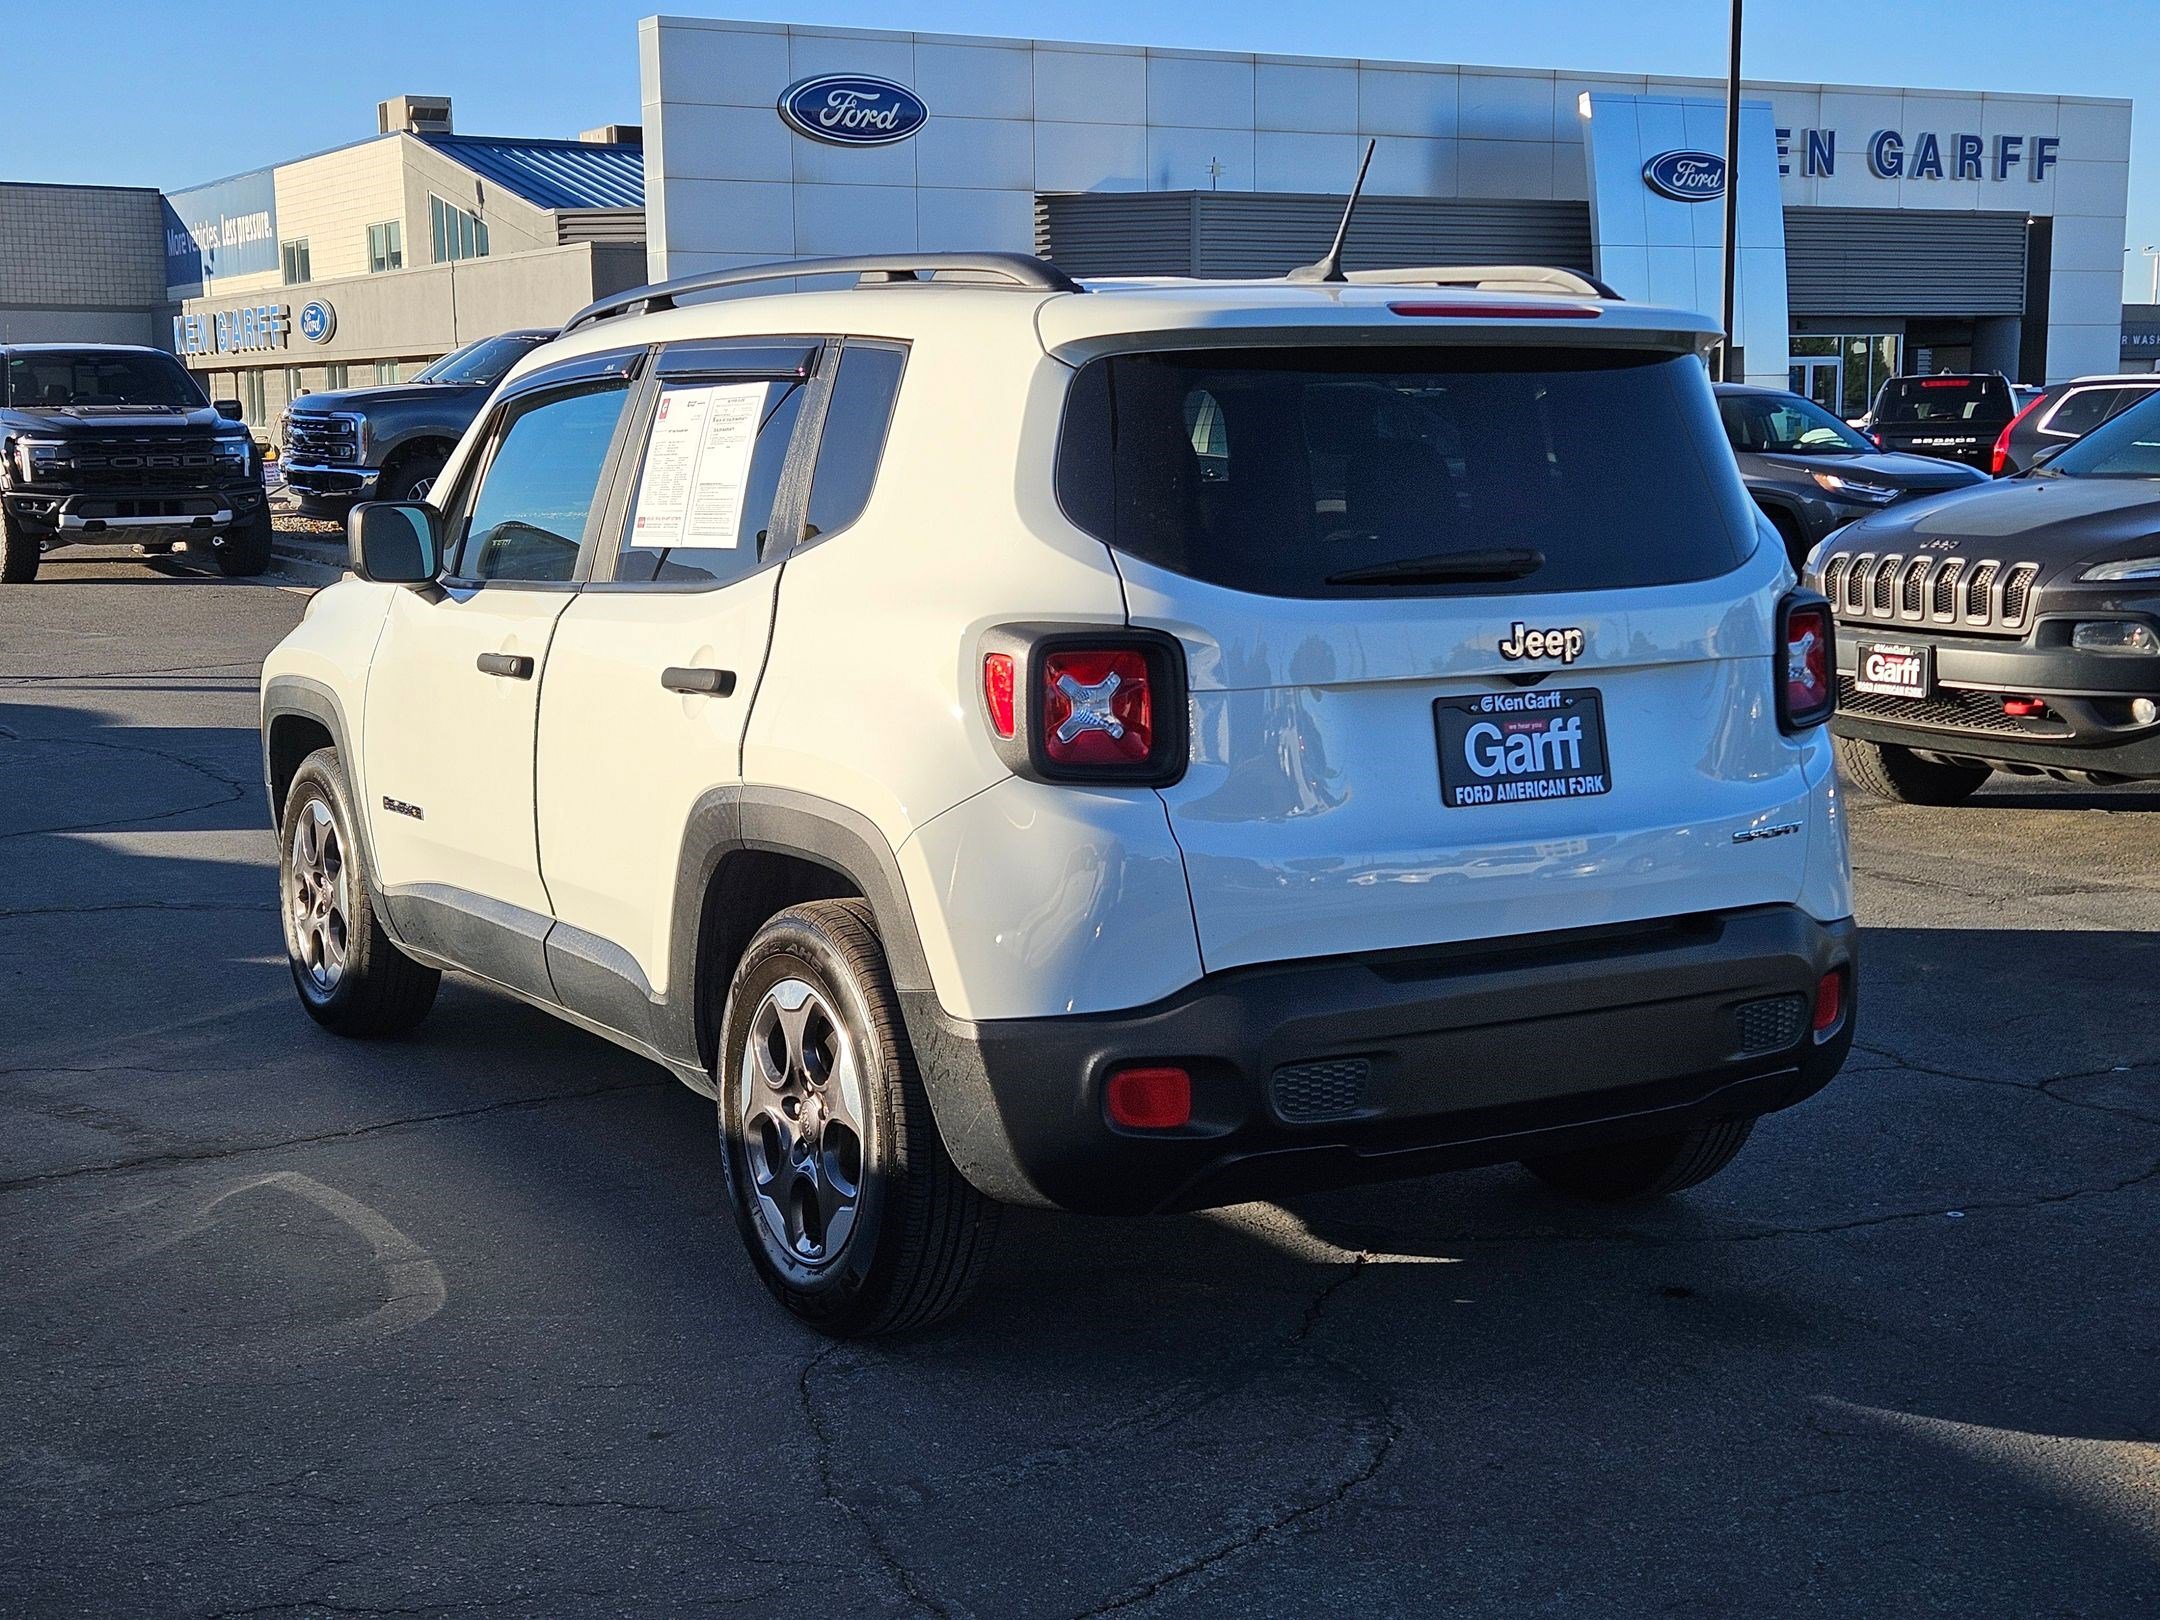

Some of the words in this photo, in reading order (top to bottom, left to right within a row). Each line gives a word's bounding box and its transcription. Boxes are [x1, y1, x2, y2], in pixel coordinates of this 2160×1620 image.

[819, 89, 901, 130] Ford
[1775, 128, 1836, 177] EN
[1869, 129, 2060, 183] GARFF
[1672, 160, 1722, 189] Ford
[167, 229, 187, 257] More
[187, 220, 220, 252] vehicles.
[220, 214, 237, 247] Less
[237, 211, 273, 249] pressure.
[173, 313, 208, 355] KEN
[215, 304, 282, 353] GARFF
[303, 308, 321, 333] Ford
[70, 454, 215, 469] FORD
[1499, 622, 1585, 664] Jeep
[1866, 654, 1921, 686] Garff
[1531, 722, 1543, 730] you
[1464, 716, 1582, 778] Garff
[1455, 785, 1494, 805] FORD
[1497, 778, 1566, 801] AMERICAN
[1568, 775, 1605, 795] FORK
